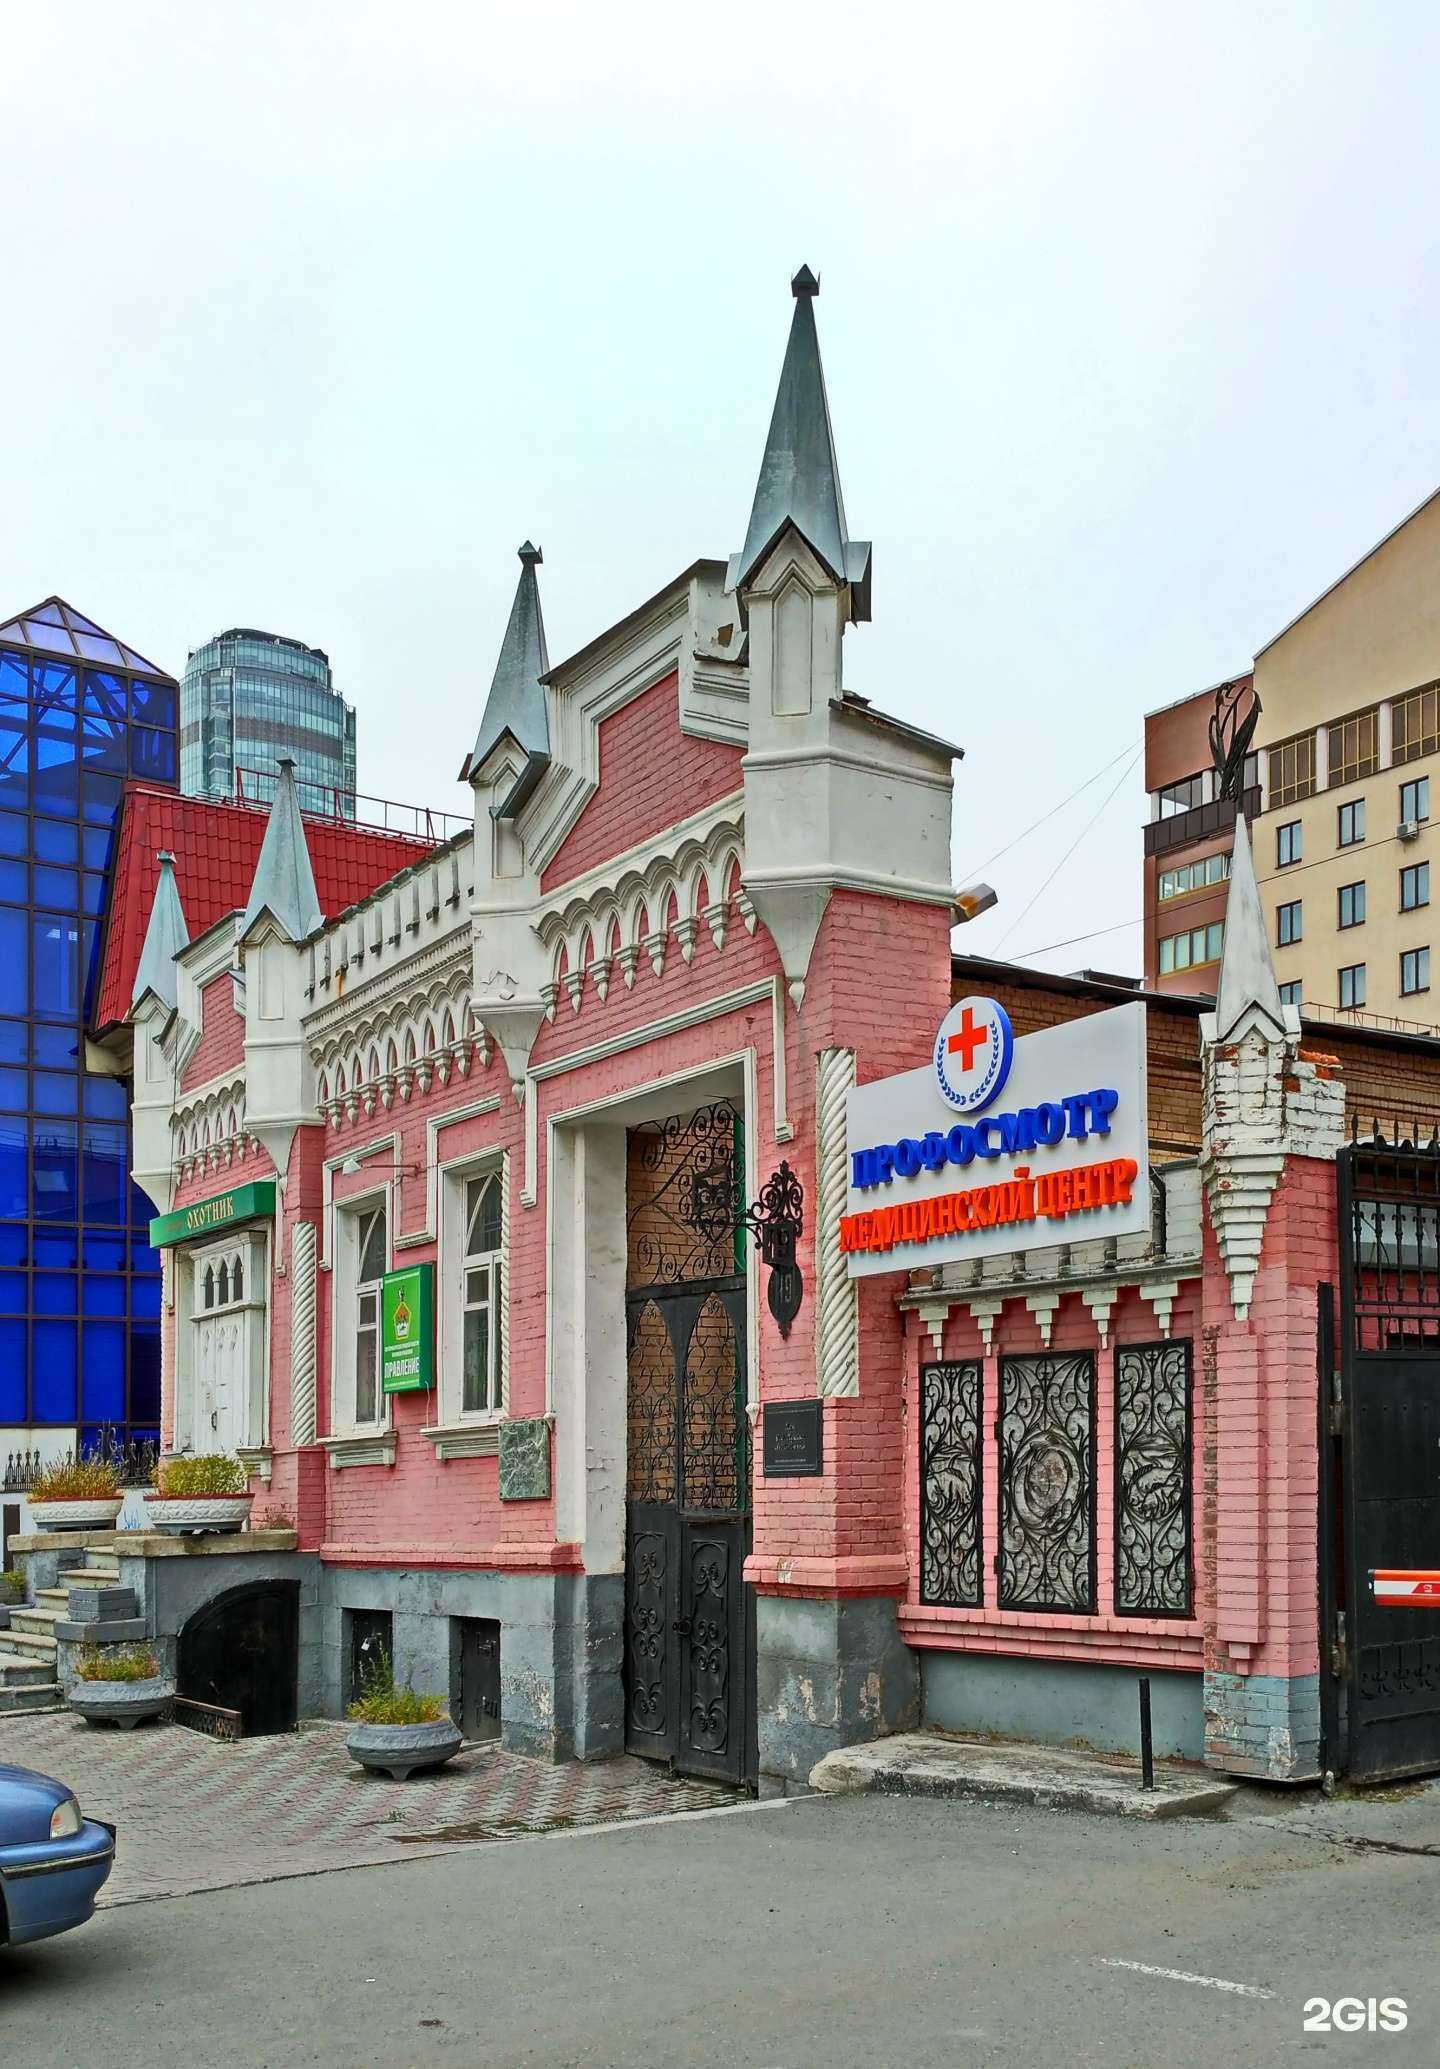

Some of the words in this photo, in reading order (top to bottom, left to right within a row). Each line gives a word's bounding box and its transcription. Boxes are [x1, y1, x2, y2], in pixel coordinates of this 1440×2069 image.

[851, 1088, 1119, 1189] ПРОФОСМОТР
[187, 1196, 234, 1229] ОХОТНИК
[839, 1166, 1036, 1252] МЕДИЦИНСКИЙ
[1036, 1158, 1138, 1217] ЦЕНТР
[384, 1356, 420, 1379] ПРАВЛЕНИЕ
